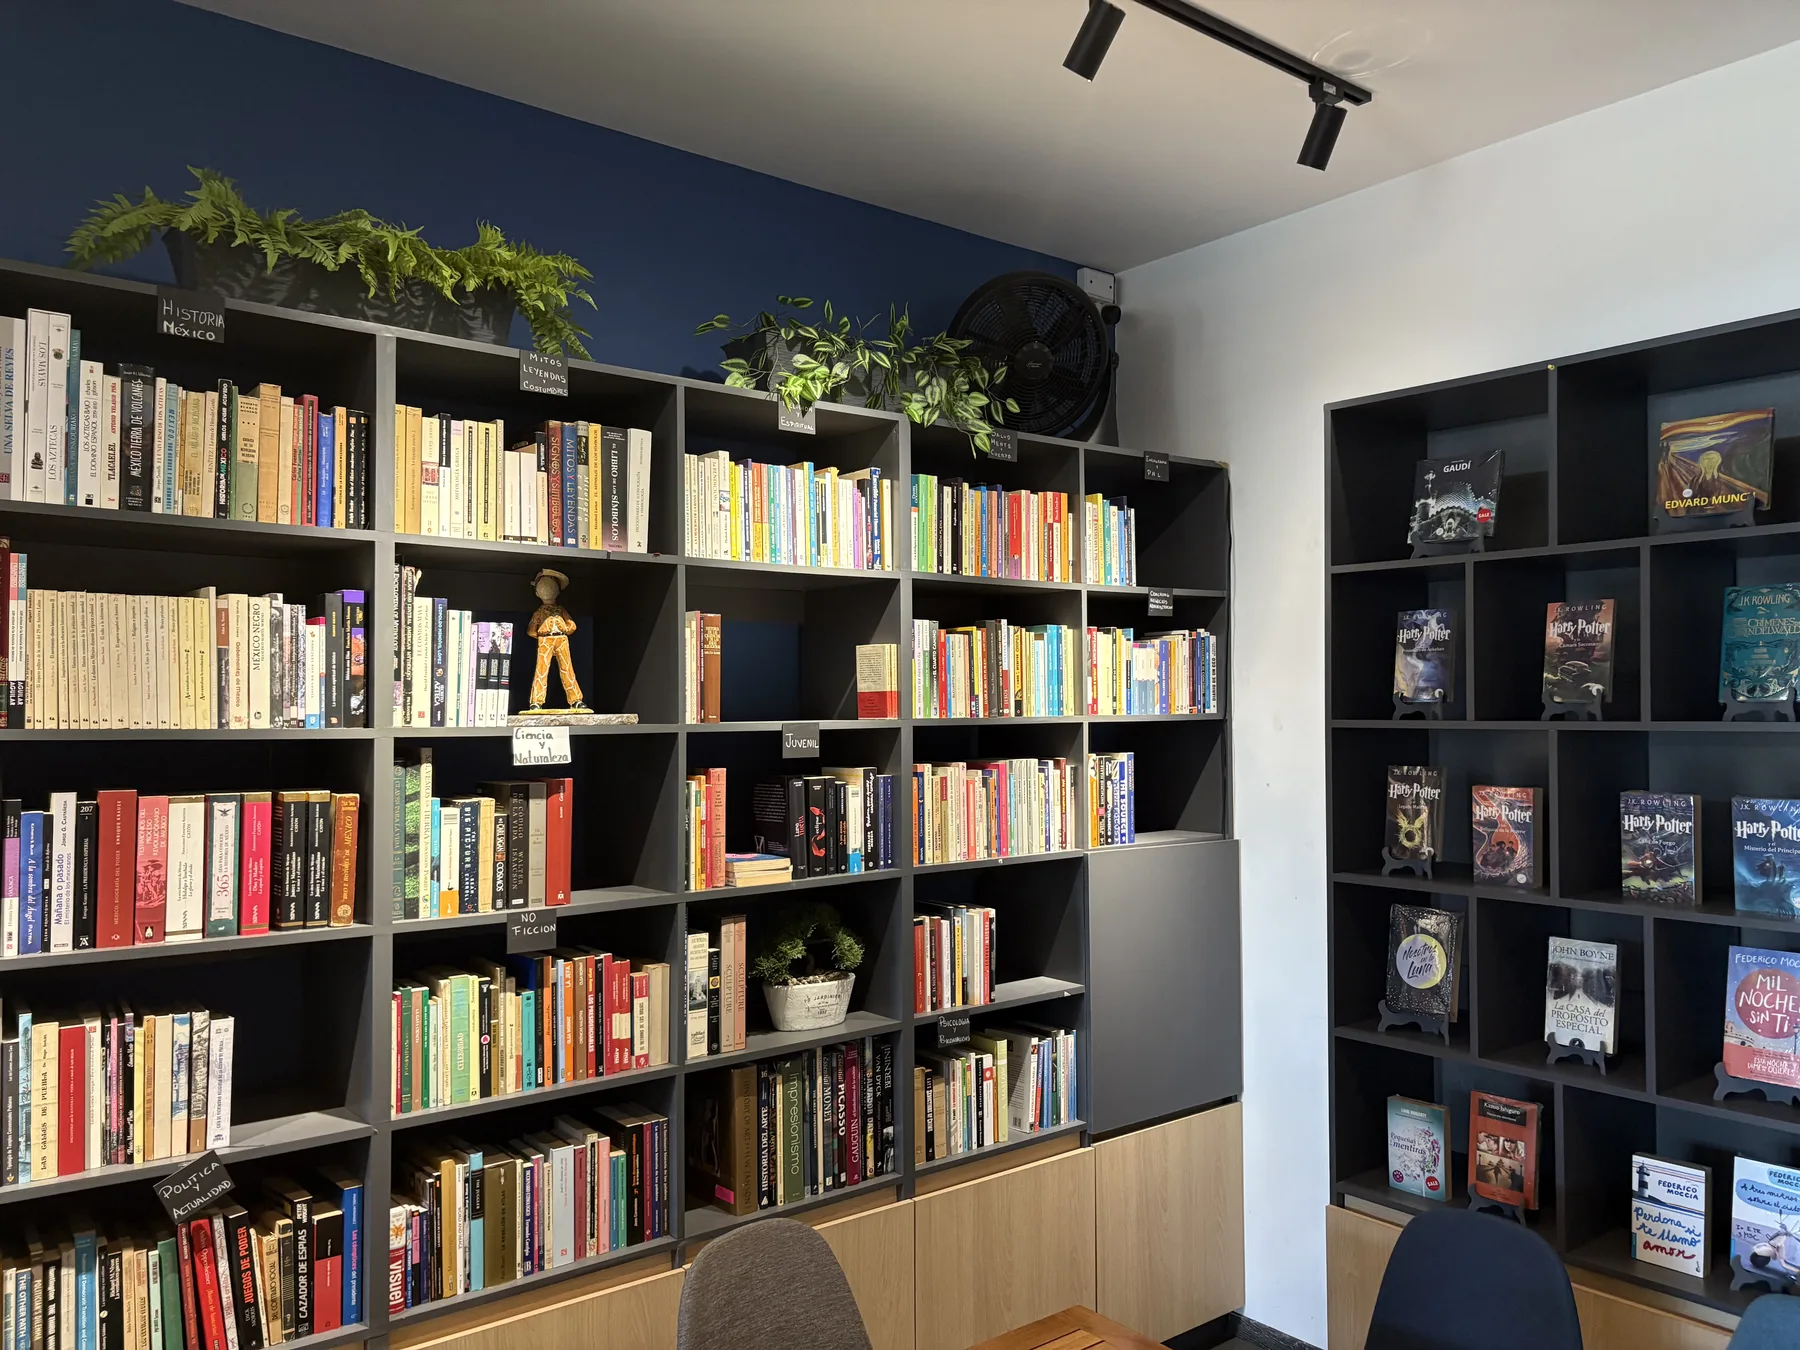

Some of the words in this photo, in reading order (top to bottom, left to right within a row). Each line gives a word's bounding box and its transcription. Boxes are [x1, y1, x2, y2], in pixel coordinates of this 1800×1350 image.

[163, 298, 224, 328] HISTORIA
[39, 342, 47, 358] LOS
[4, 348, 14, 380] REYES
[38, 360, 47, 387] MAYAS
[523, 364, 567, 384] LEYENDAS
[4, 384, 13, 397] DE
[130, 379, 143, 413] VOLCANES
[4, 400, 14, 432] SELVA
[131, 415, 143, 424] DE
[4, 433, 14, 454] UNA
[48, 424, 58, 463] AZTECAS
[130, 427, 143, 449] TIERRA
[108, 442, 116, 481] TLACAELEL
[128, 451, 142, 477] MÉXICO
[551, 437, 560, 475] SIGNOS
[566, 438, 575, 473] MITOS
[48, 464, 57, 480] LOS
[1443, 460, 1472, 473] GAUDÍ
[566, 482, 576, 534] LEYENDAS
[1664, 497, 1709, 510] EDVARD
[611, 495, 620, 541] SÍMBOLOS
[1752, 594, 1790, 606] ROWLING
[251, 603, 260, 633] NEGRO
[1549, 621, 1577, 638] Harry
[1577, 618, 1610, 638] Potter
[1397, 628, 1424, 644] Harry
[1422, 627, 1451, 643] Potter
[251, 635, 260, 671] MÉXICO
[515, 728, 554, 740] Ciencia
[786, 733, 819, 748] JUVENIL
[514, 747, 569, 764] Naturaleza
[1388, 782, 1414, 800] Harry
[1412, 782, 1440, 800] Potter
[1640, 799, 1687, 807] ROWLING
[1475, 804, 1500, 822] Harry
[1501, 804, 1532, 824] Potter
[1622, 814, 1655, 832] Harry
[1655, 814, 1692, 834] Potter
[1734, 820, 1770, 840] Harry
[55, 854, 65, 883] pasado
[216, 874, 229, 896] 365
[54, 893, 63, 925] Mañana
[521, 912, 537, 922] NO
[512, 924, 556, 936] FICCION
[1552, 945, 1577, 956] JOHN
[1579, 948, 1614, 961] BOYNE
[1406, 962, 1433, 980] Luna
[1551, 1010, 1608, 1027] PROPÓSITO
[1554, 1002, 1564, 1011] La
[1566, 1004, 1591, 1016] CASA
[1593, 1008, 1606, 1018] del
[1556, 1018, 1603, 1036] ESPECIAL
[761, 1070, 768, 1078] 16
[823, 1087, 832, 1122] MONET
[1500, 1104, 1520, 1116] Ishiguro
[788, 1073, 800, 1174] Impresionismo
[851, 1118, 860, 1162] GAUGUIN
[1392, 1142, 1427, 1156] mentiras
[159, 1162, 220, 1198] POLITICA
[1658, 1179, 1698, 1194] FEDERICO
[172, 1180, 232, 1219] ACTUALIDAD
[1666, 1188, 1699, 1200] MOCCIA
[1634, 1206, 1685, 1228] Perdona
[1685, 1224, 1701, 1238] si
[237, 1226, 249, 1256] PODER
[297, 1229, 307, 1260] ESPIAS
[1636, 1222, 1658, 1238] te
[1658, 1229, 1700, 1247] llamo
[1642, 1240, 1696, 1260] amor
[241, 1258, 251, 1270] DE
[298, 1261, 307, 1273] DE
[242, 1271, 254, 1303] JUEGOS
[298, 1275, 308, 1318] CAZADOR
